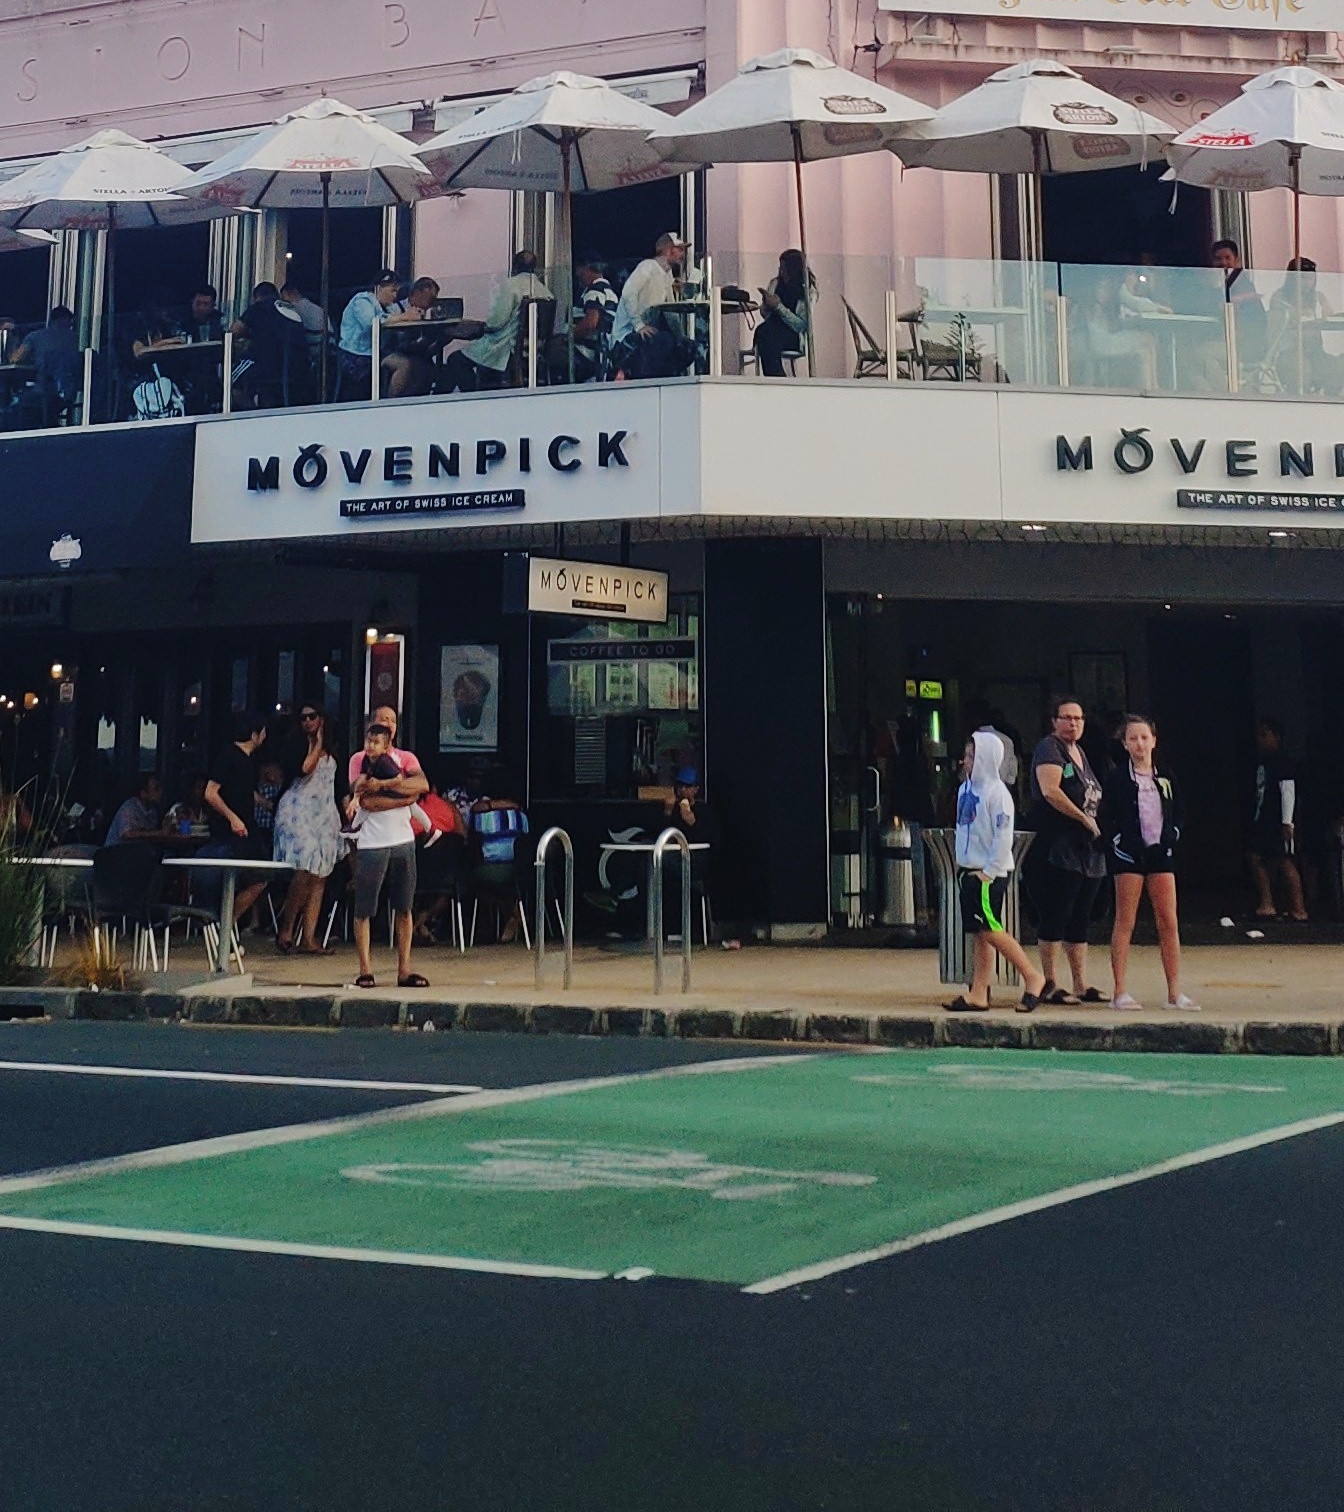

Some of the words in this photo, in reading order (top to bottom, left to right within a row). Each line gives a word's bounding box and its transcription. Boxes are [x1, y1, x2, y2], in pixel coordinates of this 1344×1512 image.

[1198, 138, 1245, 146] STELLA
[346, 502, 366, 513] THE
[370, 500, 392, 511] ART
[395, 499, 410, 509] OF
[414, 497, 447, 508] SWISS
[452, 495, 471, 506] ICE
[474, 493, 513, 505] CREAM
[1188, 492, 1213, 503] THE
[1218, 494, 1243, 505] ART
[1247, 495, 1265, 505] OF
[1270, 496, 1309, 507] SWISS
[1314, 497, 1337, 508] ICE
[569, 646, 623, 657] COFFEE
[631, 644, 649, 656] TO
[655, 644, 676, 655] GO
